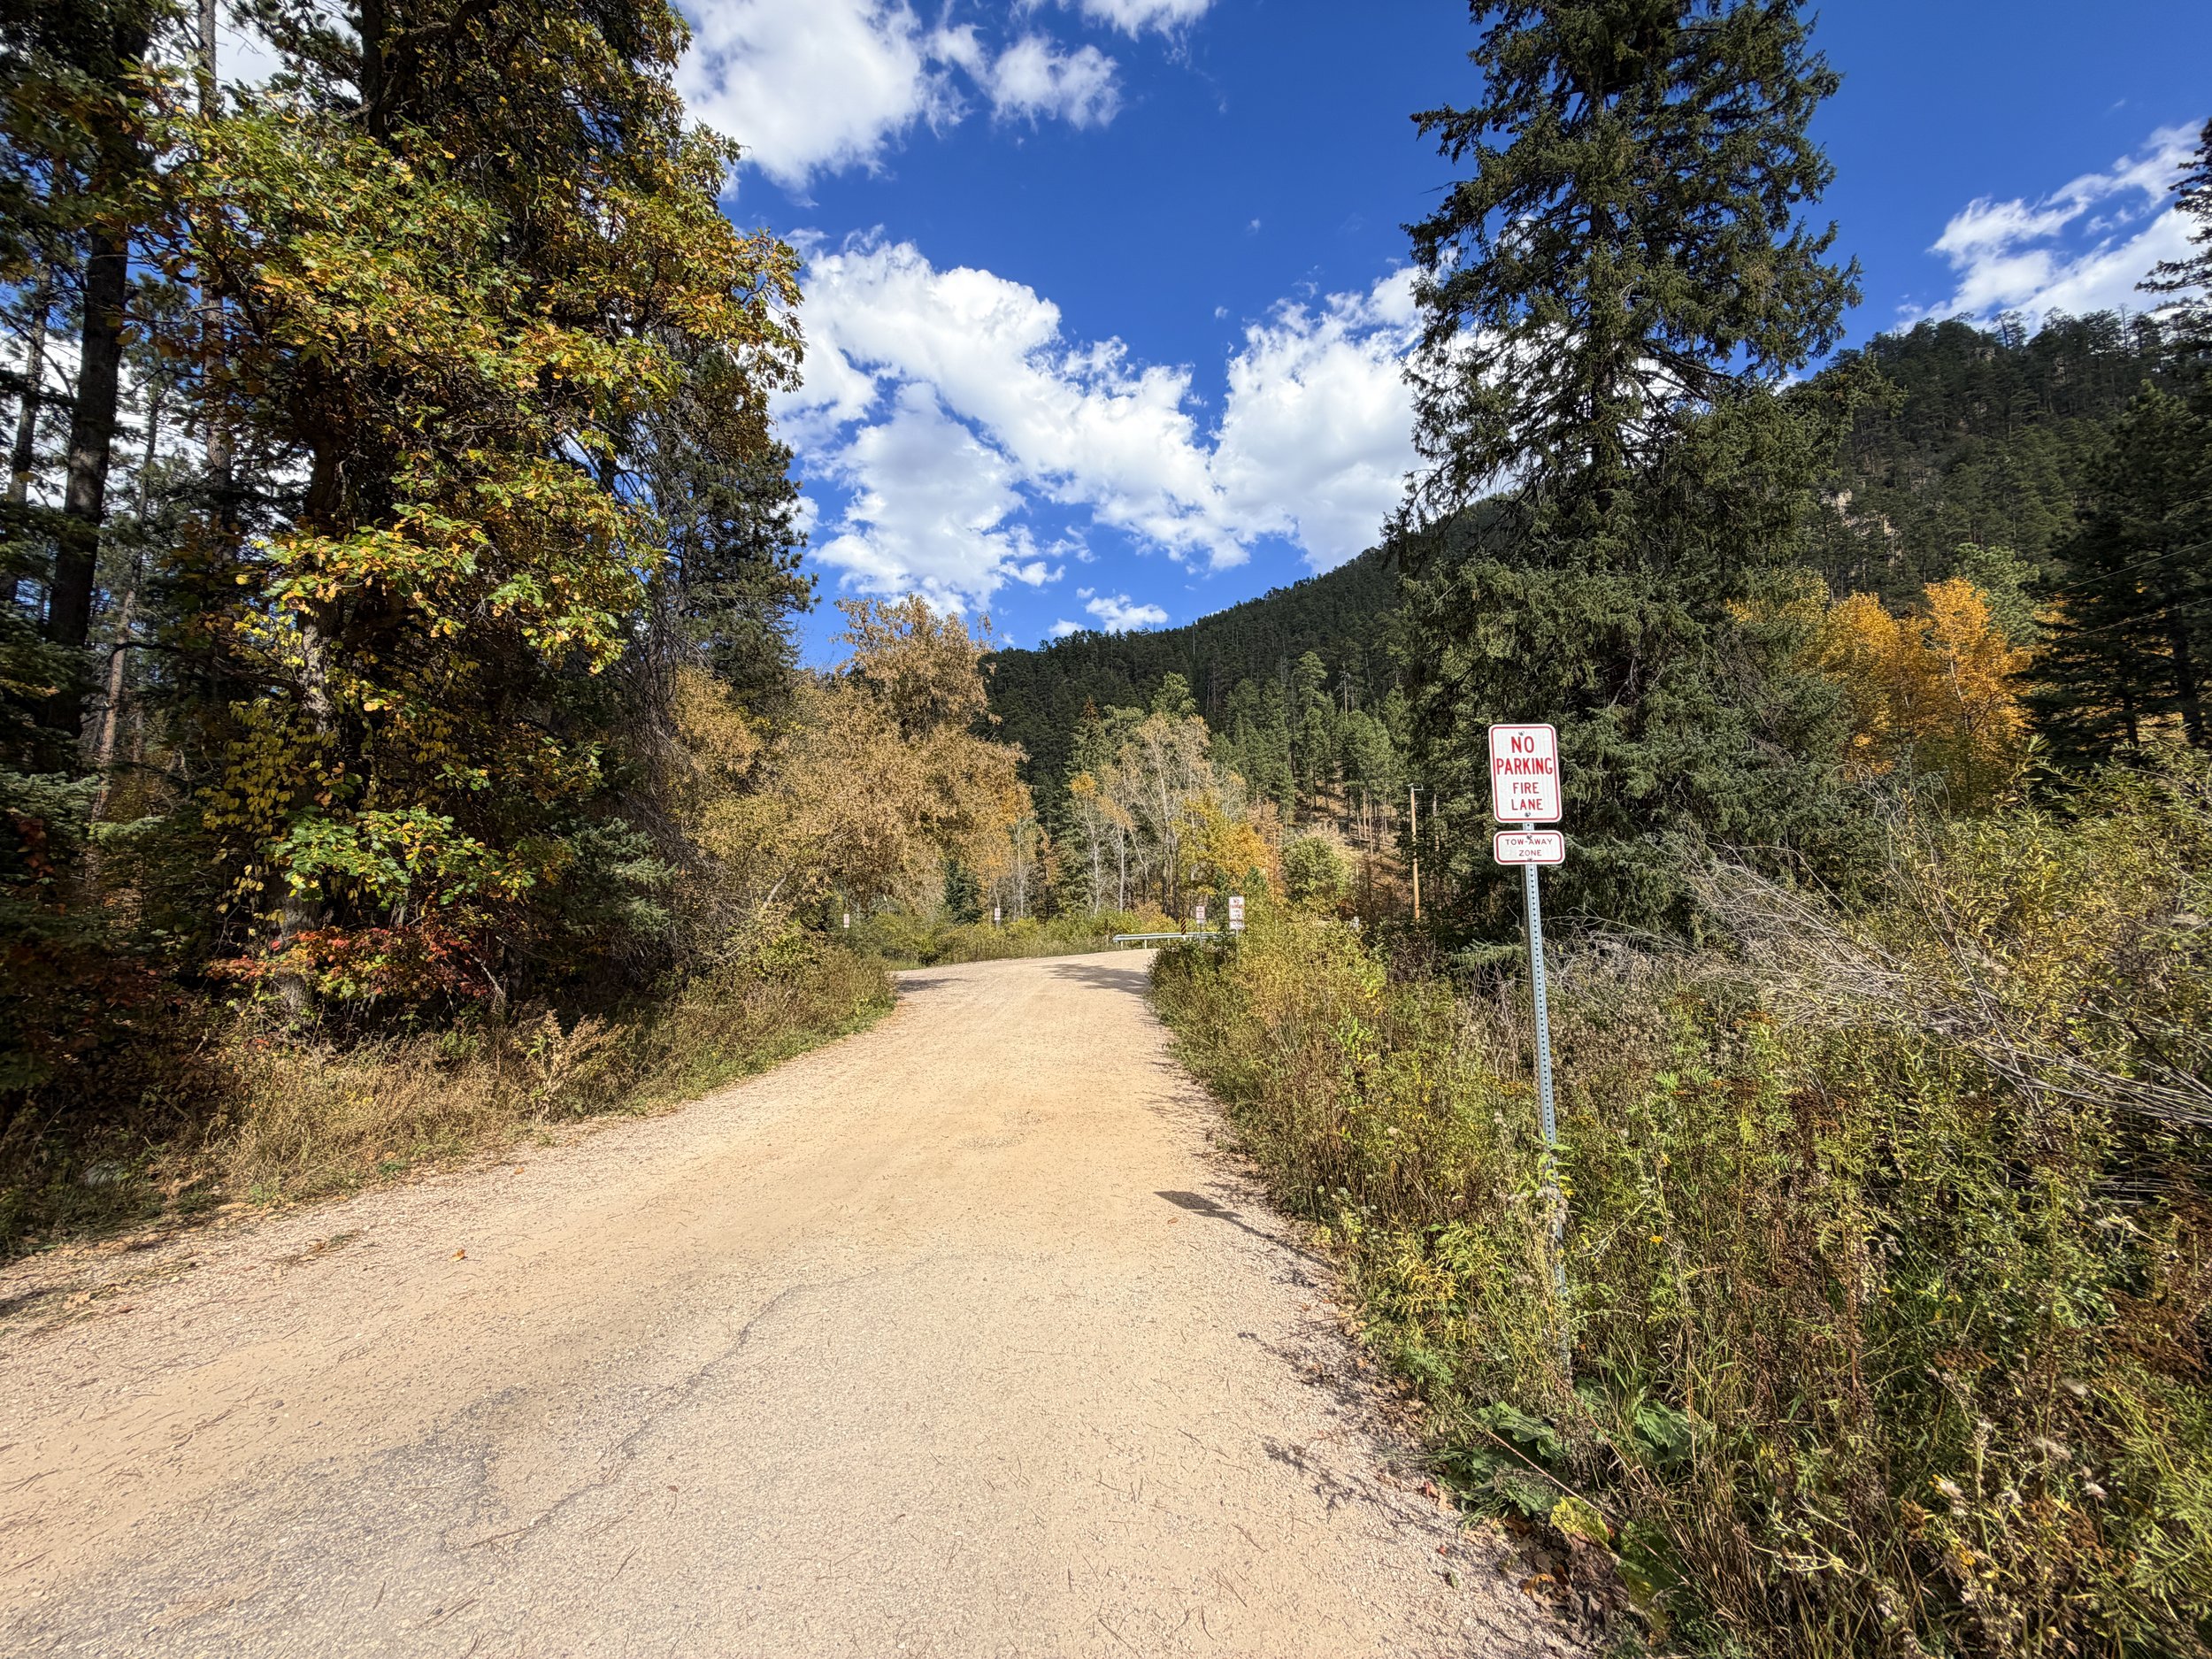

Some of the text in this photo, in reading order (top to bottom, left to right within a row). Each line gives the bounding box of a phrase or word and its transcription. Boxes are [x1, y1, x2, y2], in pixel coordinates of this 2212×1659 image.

[1511, 736, 1534, 753] NO
[1496, 757, 1553, 775] PARKING
[1513, 782, 1540, 794] FIRE
[1511, 799, 1543, 810] LANE
